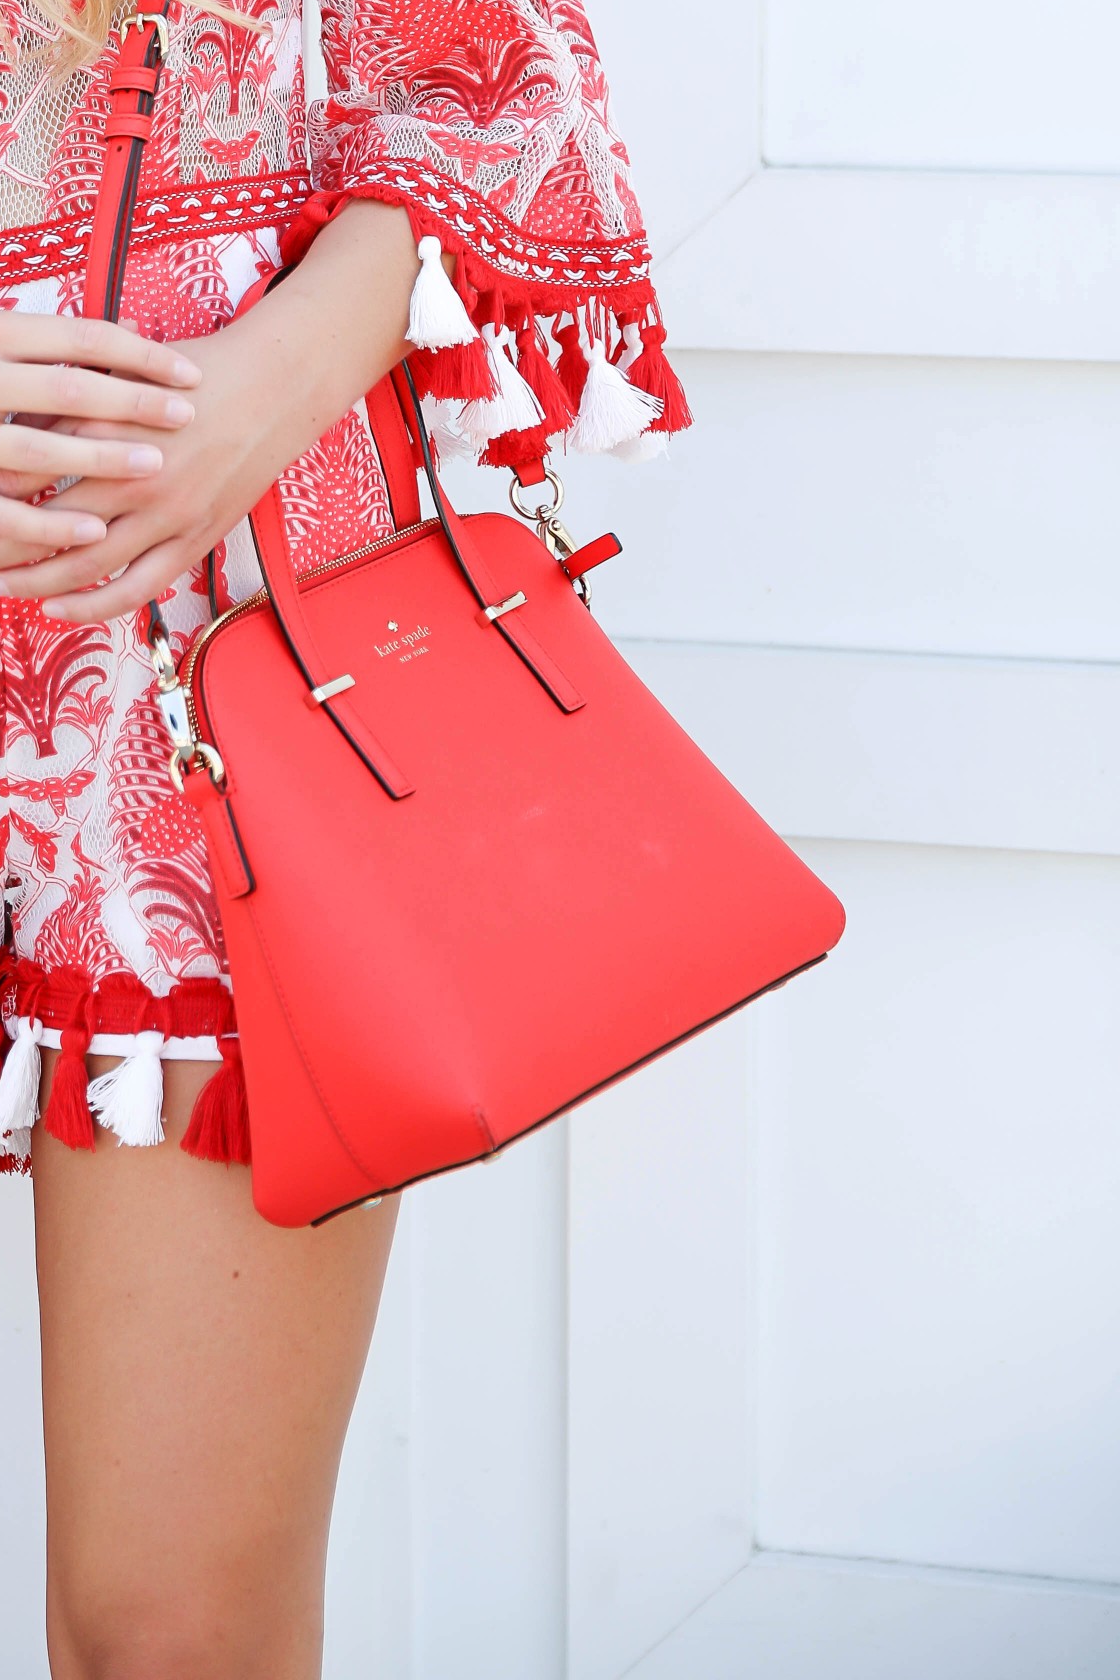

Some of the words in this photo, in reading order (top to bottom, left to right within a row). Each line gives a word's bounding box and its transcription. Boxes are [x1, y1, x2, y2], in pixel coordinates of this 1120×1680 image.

[374, 641, 401, 658] kate
[401, 625, 432, 647] spade
[399, 654, 412, 663] NEW
[413, 646, 429, 657] YORK
